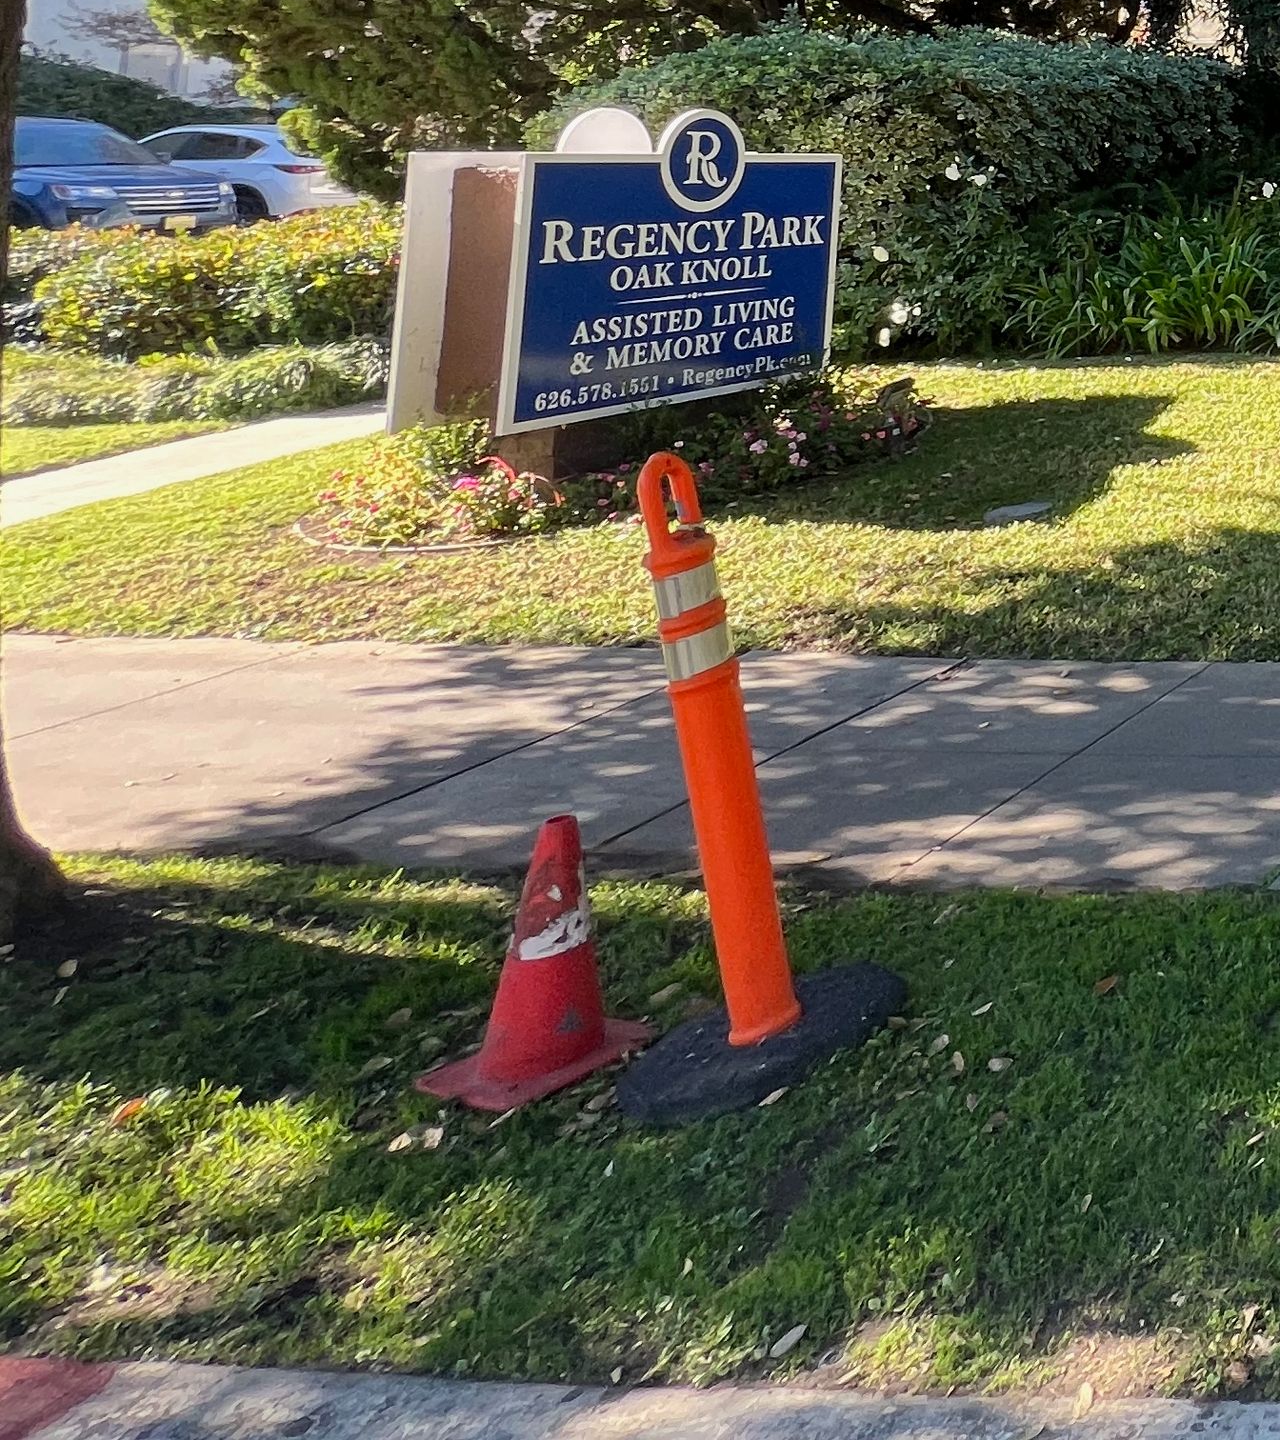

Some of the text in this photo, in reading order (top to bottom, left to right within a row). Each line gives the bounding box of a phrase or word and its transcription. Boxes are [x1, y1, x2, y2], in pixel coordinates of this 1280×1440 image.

[683, 130, 727, 187] R
[538, 211, 825, 265] REGENCY PARK
[609, 254, 772, 291] OAK KNOLL
[569, 296, 795, 346] ASSISTED LIVING
[569, 322, 794, 376] & MEMORY CARE
